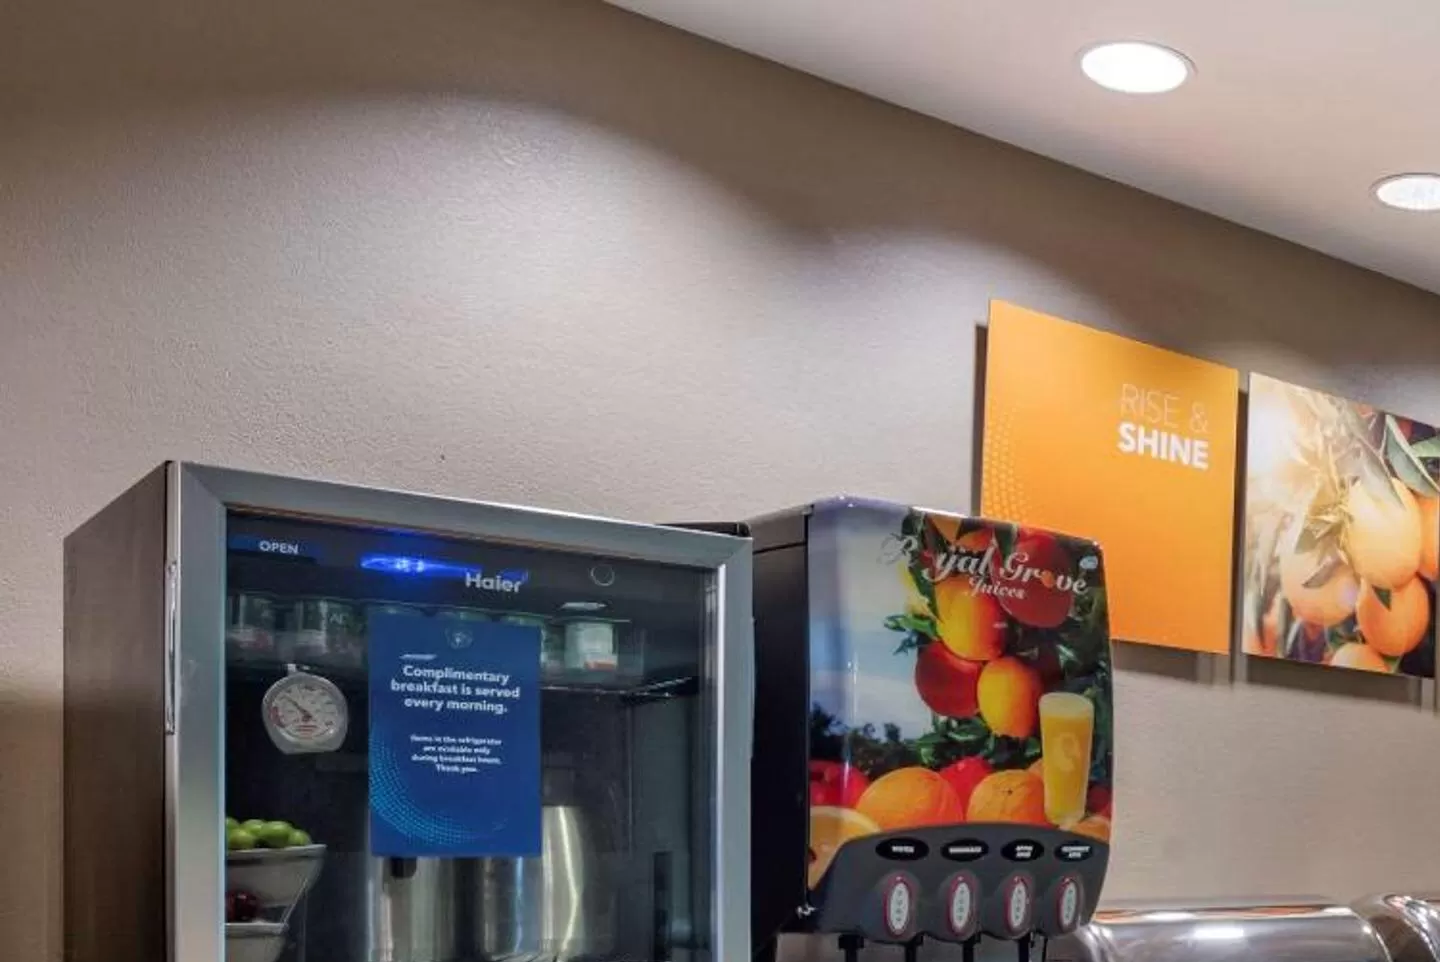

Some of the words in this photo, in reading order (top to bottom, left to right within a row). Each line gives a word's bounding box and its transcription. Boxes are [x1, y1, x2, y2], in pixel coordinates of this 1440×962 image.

[1120, 383, 1180, 428] RISE
[1190, 401, 1209, 433] &
[1117, 421, 1209, 471] SHINE
[259, 540, 300, 555] OPEN
[465, 572, 523, 593] Haier
[969, 576, 1027, 600] Juices
[403, 665, 510, 686] Complimentary
[390, 678, 458, 695] breakfast
[461, 683, 472, 695] is
[475, 686, 521, 699] served
[404, 698, 444, 712] every
[446, 700, 508, 715] morning.
